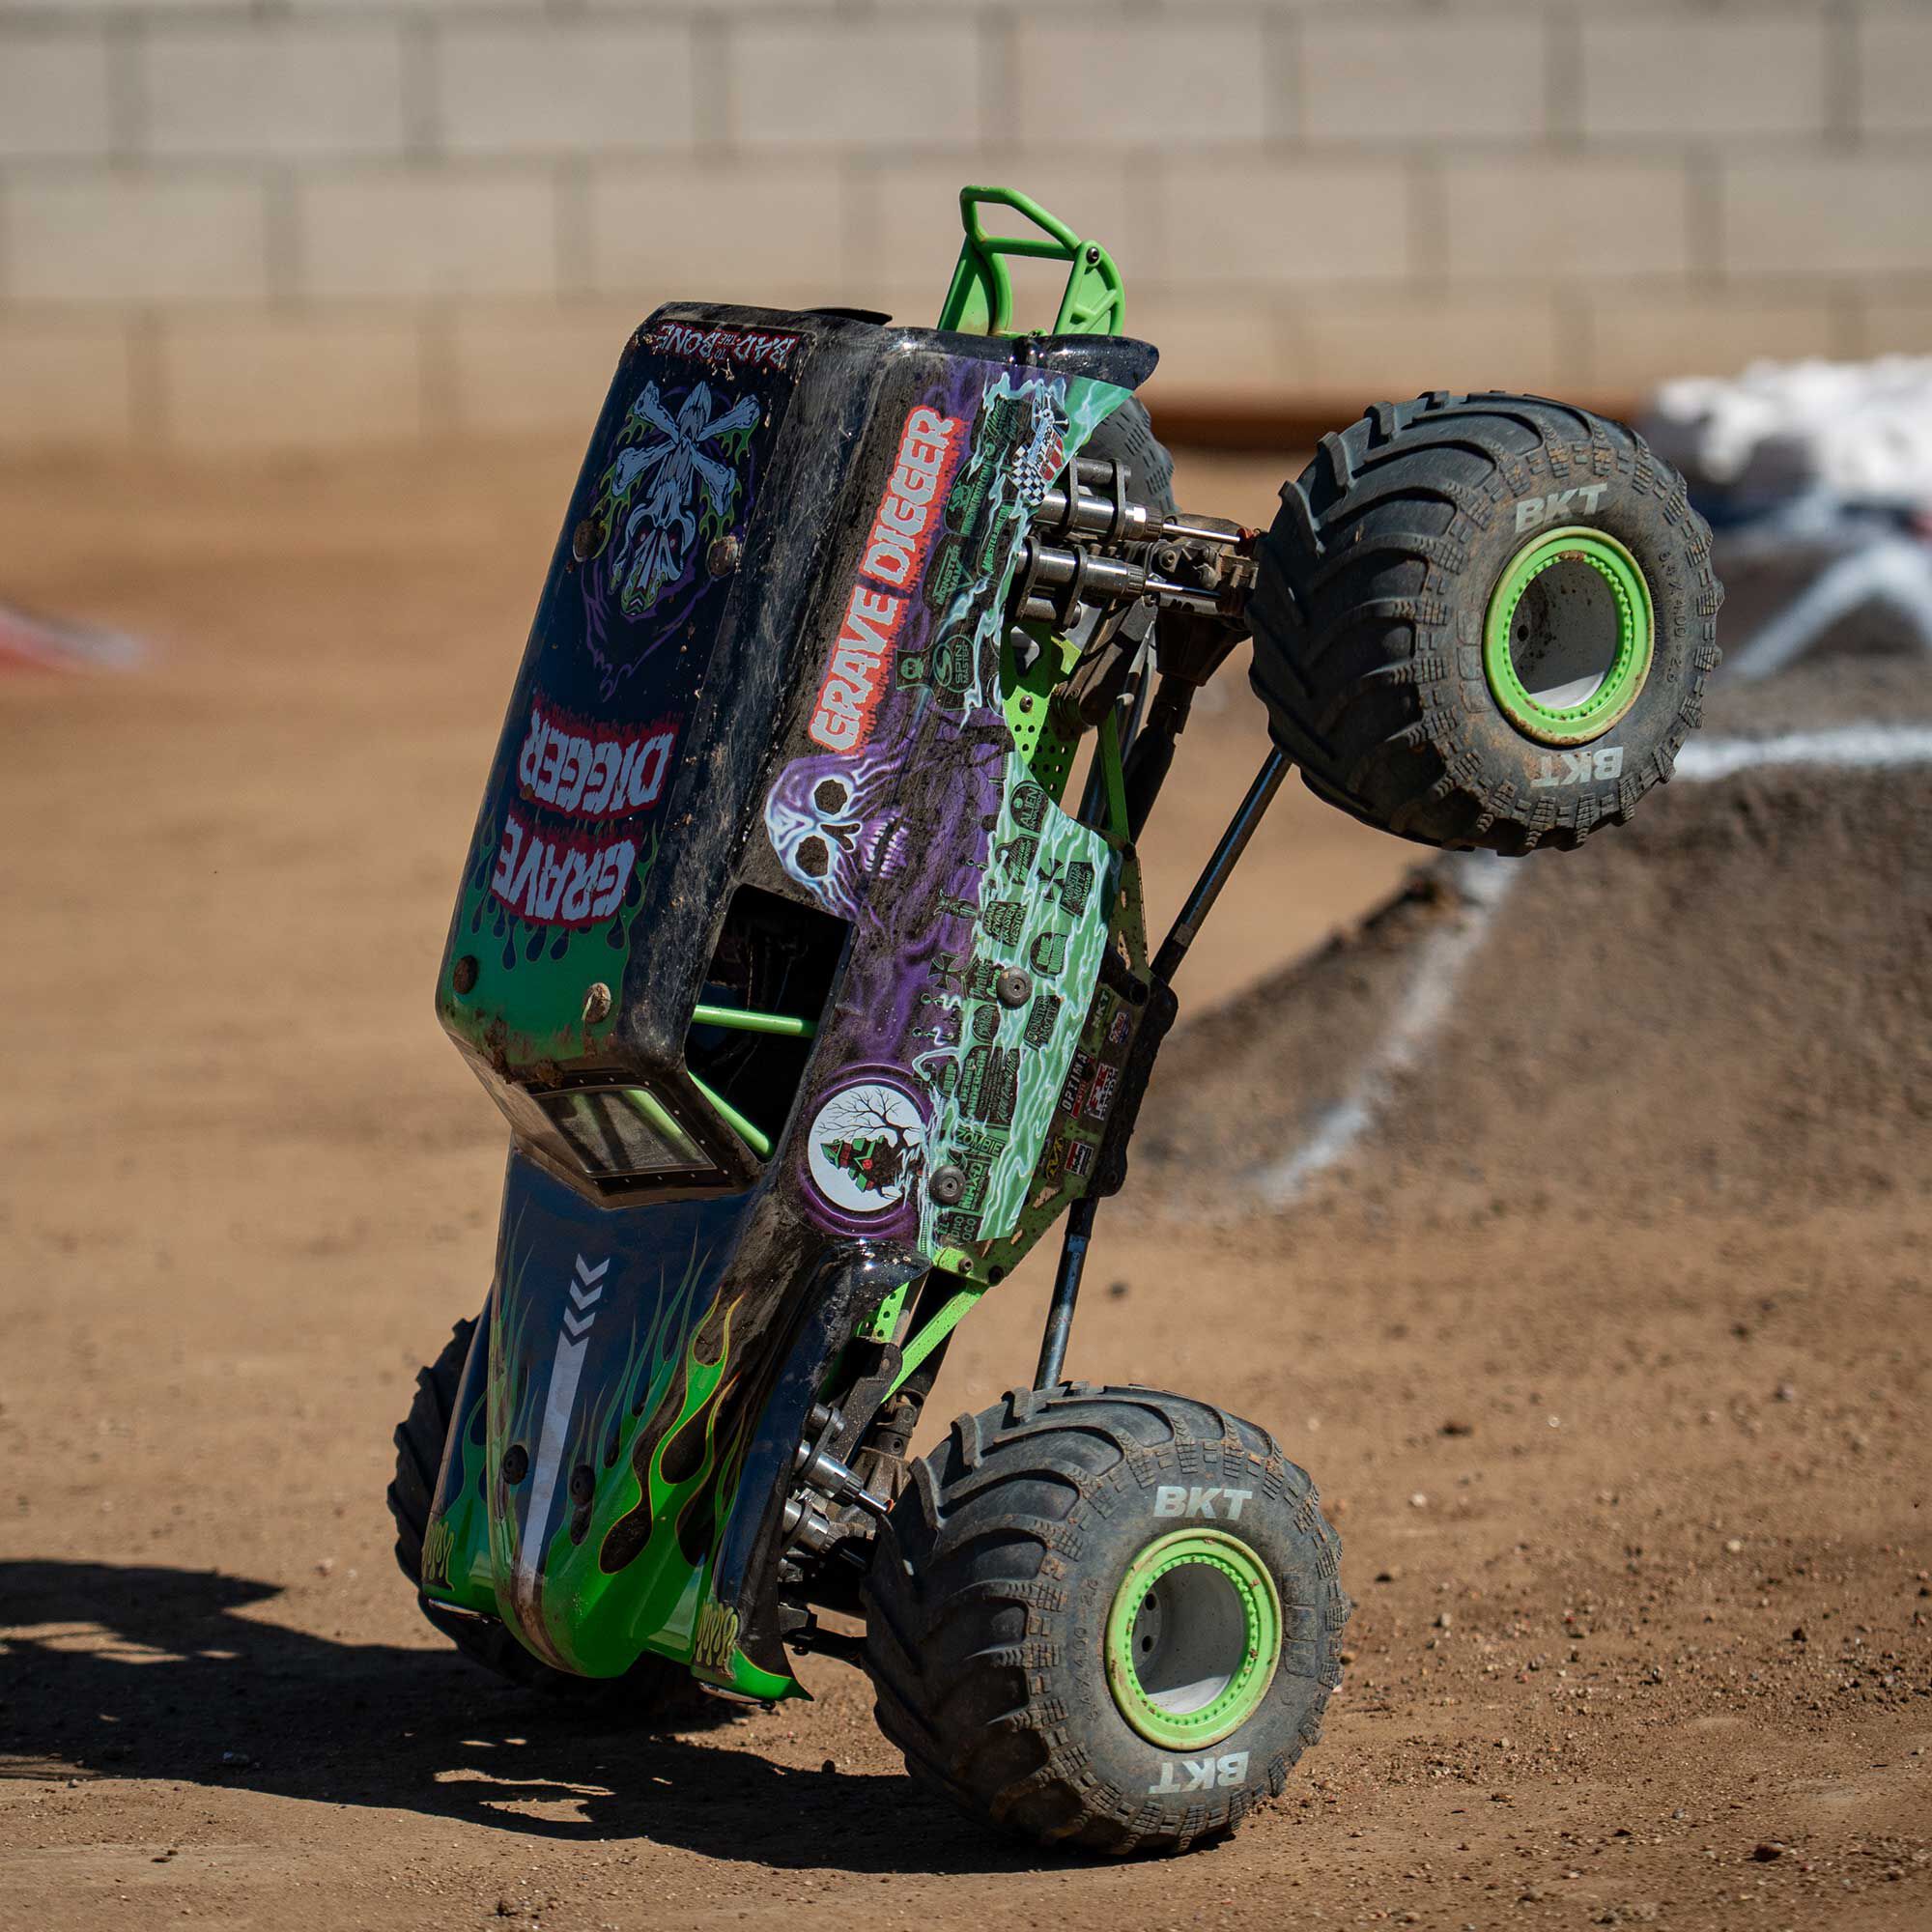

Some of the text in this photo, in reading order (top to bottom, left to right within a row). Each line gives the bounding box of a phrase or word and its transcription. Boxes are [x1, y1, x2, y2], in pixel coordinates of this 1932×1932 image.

[657, 324, 721, 358] BONE
[734, 334, 795, 365] BAD
[1516, 483, 1607, 531] BKT
[810, 409, 955, 750] GRAVE DIGGER
[936, 544, 960, 604] MONSTER
[520, 708, 674, 814] DIGGER
[1531, 747, 1624, 788] BKT
[1019, 787, 1038, 826] ALIEN
[491, 813, 636, 921] GRAVE
[1063, 864, 1080, 903] MONSTER
[983, 901, 998, 932] ADAM
[991, 905, 1006, 935] RYAN
[1028, 995, 1051, 1041] MONSTER
[960, 1059, 975, 1101] DENNIS
[967, 1050, 987, 1115] ANDERSON
[1063, 1052, 1088, 1111] OPTIMA
[956, 1127, 1004, 1156] ZOMBIE
[1152, 1486, 1252, 1520] BKT
[1149, 1751, 1249, 1794] BKT
